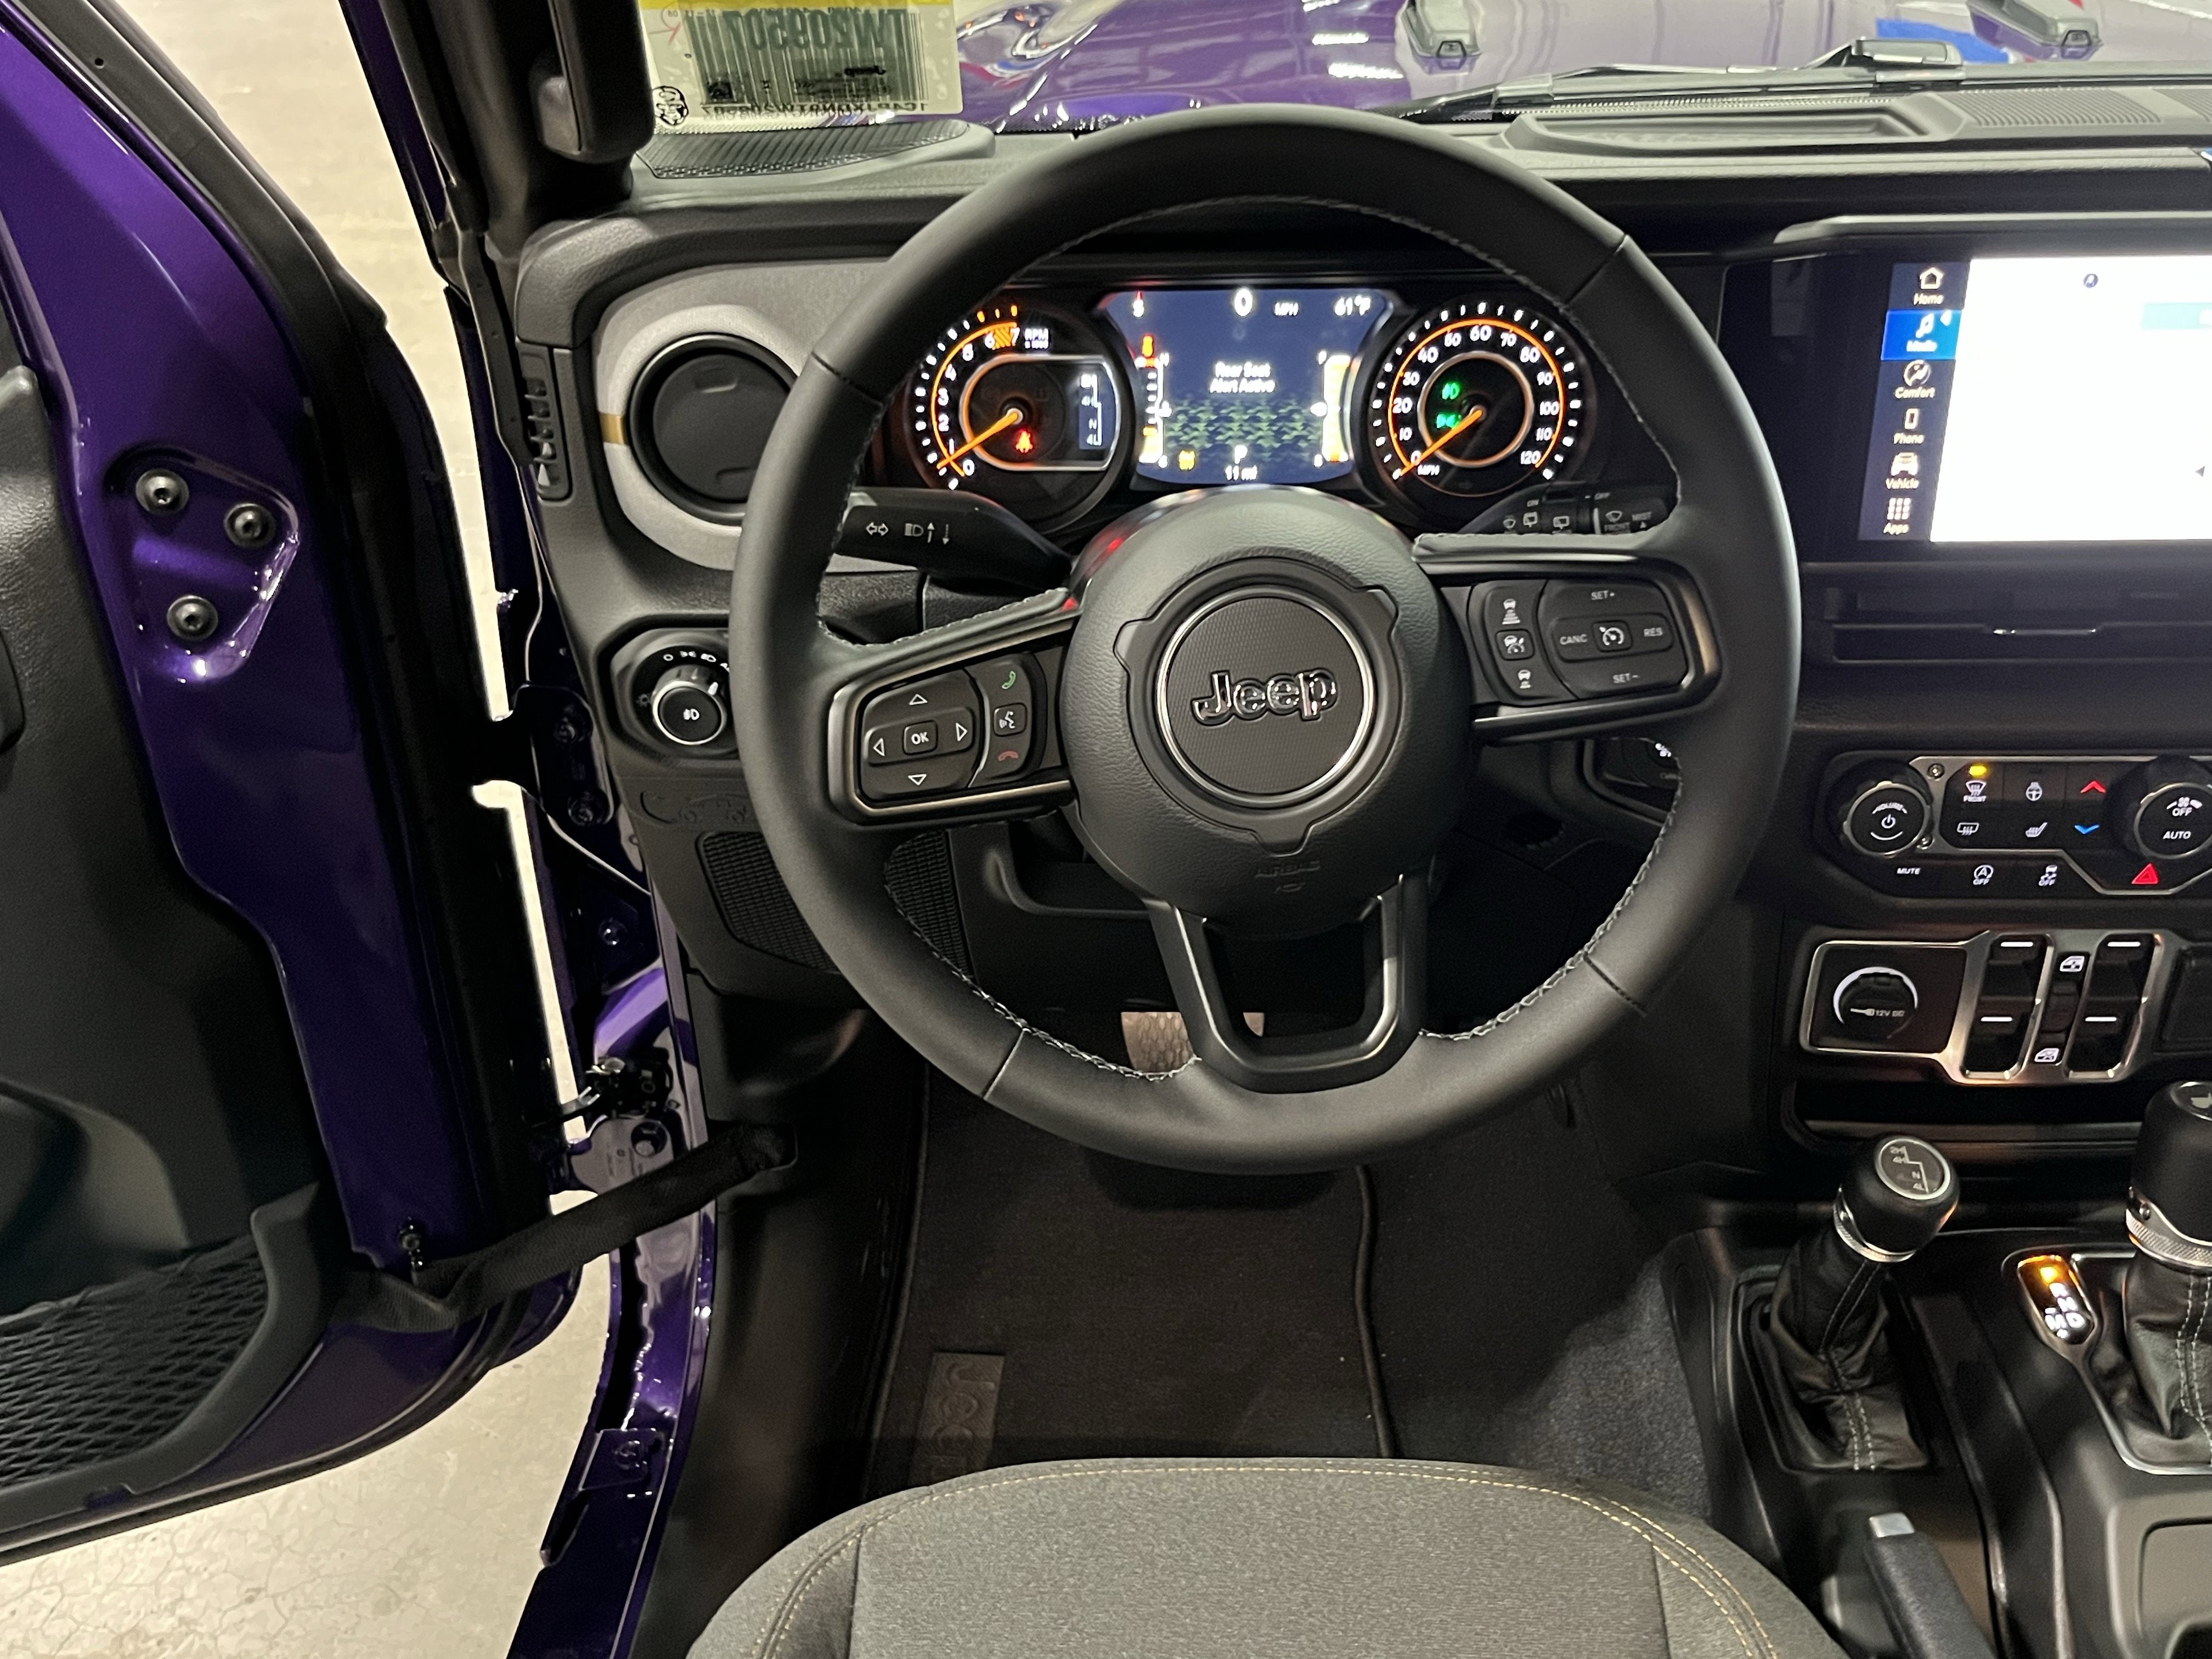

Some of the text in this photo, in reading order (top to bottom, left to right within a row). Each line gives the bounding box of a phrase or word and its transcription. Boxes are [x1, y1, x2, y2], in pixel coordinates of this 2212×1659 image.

[1234, 289, 1254, 317] 0
[1913, 292, 1944, 305] Home
[984, 330, 995, 349] 6
[1010, 327, 1020, 347] 7
[1470, 325, 1492, 342] 60
[1500, 333, 1517, 347] 70
[1418, 346, 1438, 363] 40
[945, 363, 957, 381] 4
[1403, 371, 1420, 386] 30
[1537, 371, 1553, 386] 90
[937, 387, 949, 406] 3
[1894, 386, 1936, 399] Comfort
[1392, 397, 1413, 414] 20
[1539, 400, 1560, 416] 100
[938, 413, 950, 432] 2
[1399, 427, 1412, 441] 10
[1536, 427, 1553, 441] 110
[1893, 432, 1926, 444] Phone
[948, 438, 955, 455] 1
[1234, 444, 1248, 465] P
[1520, 450, 1542, 465] 120
[963, 459, 975, 476] 0
[1417, 464, 1441, 476] MPH
[1886, 477, 1920, 489] Vehicle
[1883, 522, 1909, 535] Apps
[1560, 634, 1588, 645] CANC
[1644, 627, 1663, 637] RES
[1192, 668, 1338, 727] Jeep
[911, 731, 929, 744] OK
[2172, 807, 2193, 817] OFF
[2163, 830, 2192, 840] AUTO
[2065, 1312, 2085, 1329] D
